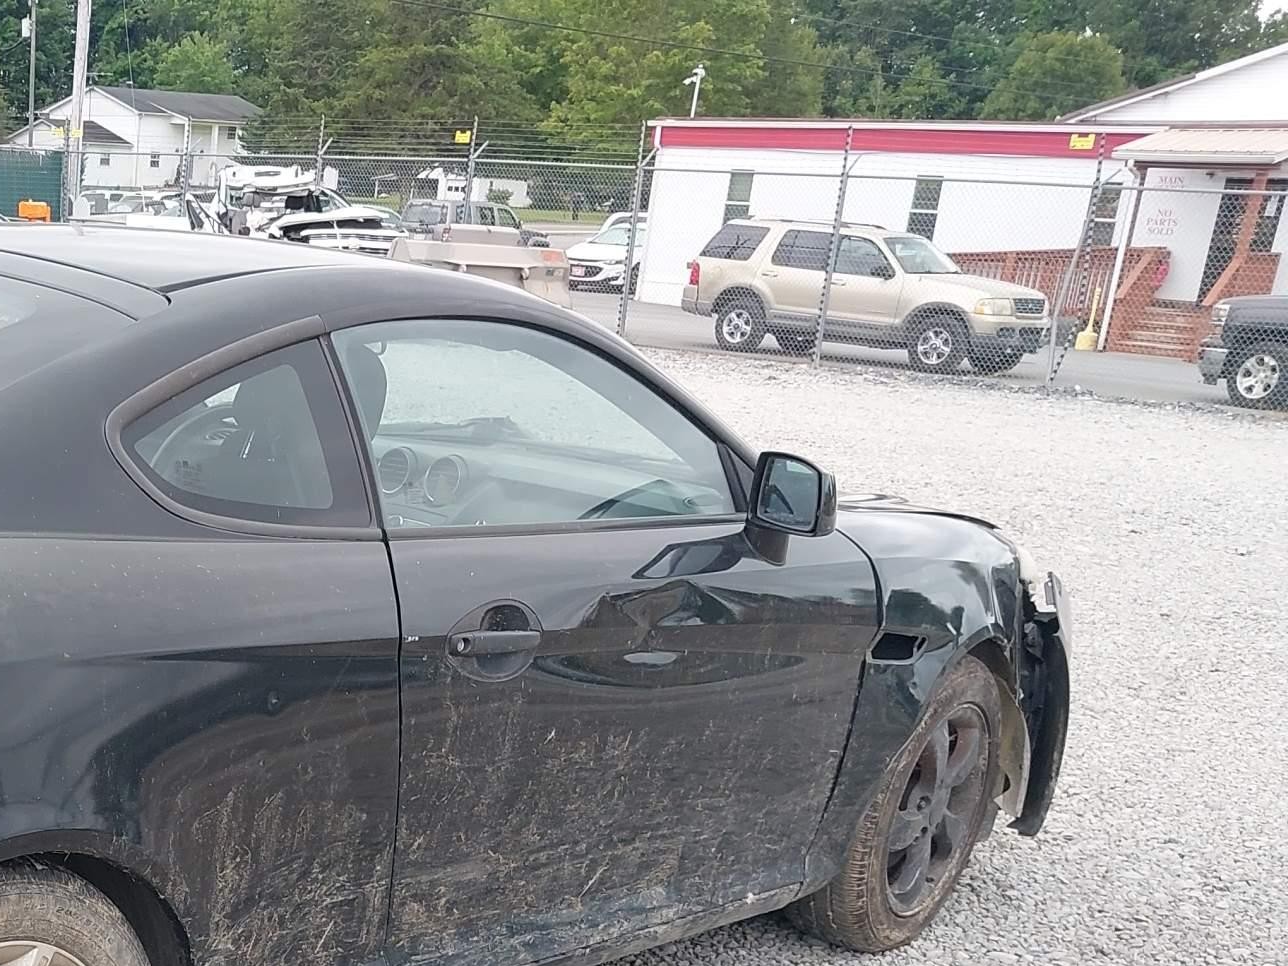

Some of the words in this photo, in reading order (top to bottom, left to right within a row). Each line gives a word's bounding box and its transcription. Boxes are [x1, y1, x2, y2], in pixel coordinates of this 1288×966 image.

[1158, 176, 1185, 184] MAIN
[1158, 208, 1174, 217] NO
[1146, 218, 1178, 227] PARTS
[1147, 227, 1174, 235] SOLD
